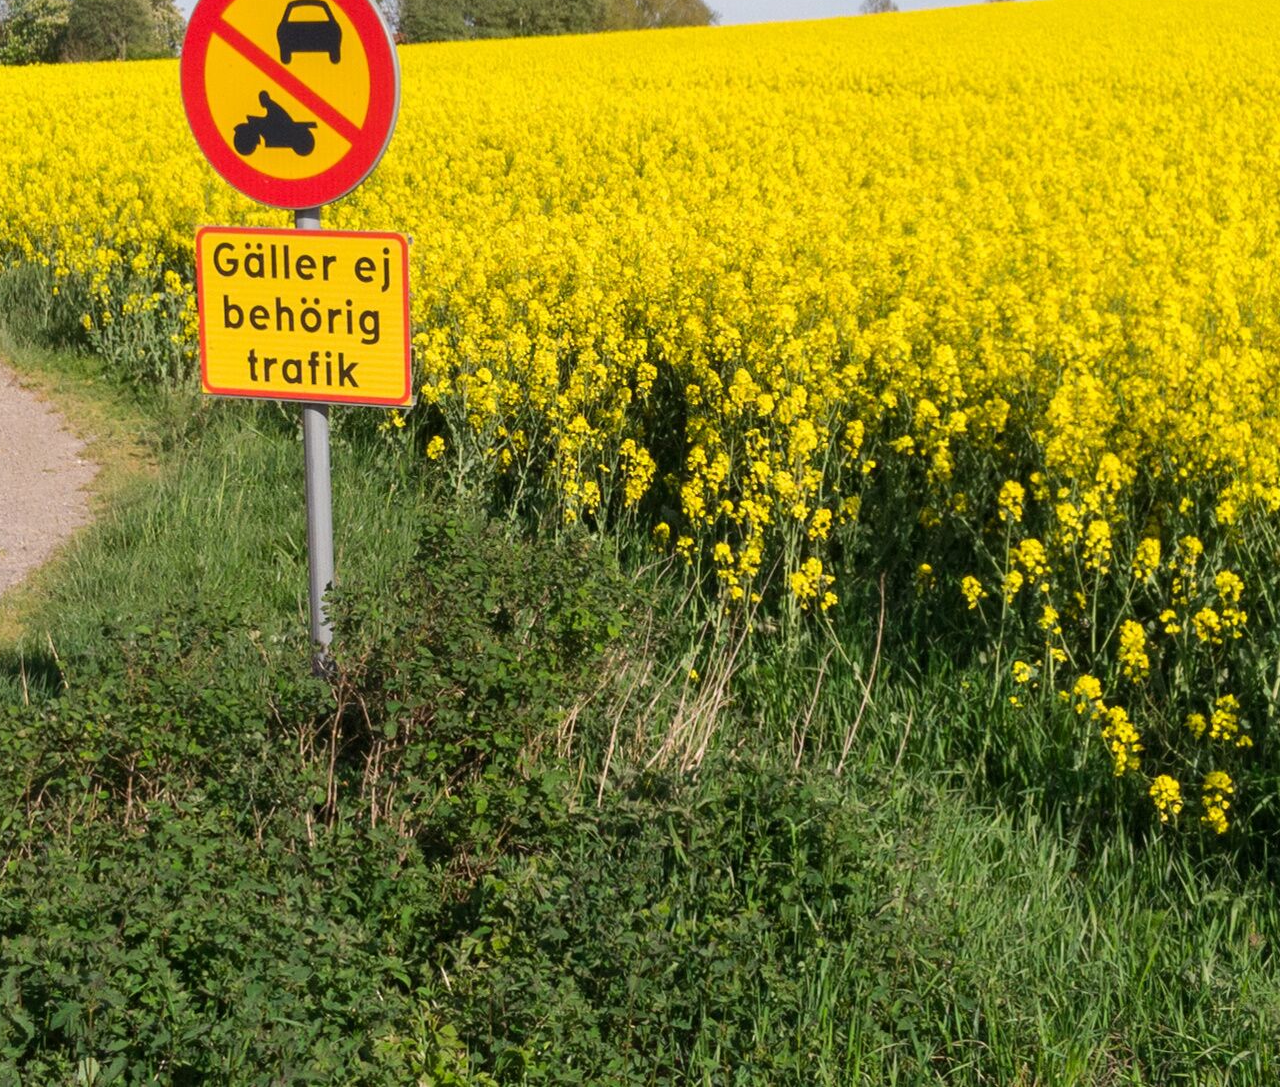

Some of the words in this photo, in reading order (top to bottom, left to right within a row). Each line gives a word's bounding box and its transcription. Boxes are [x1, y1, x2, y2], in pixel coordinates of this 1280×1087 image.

[213, 242, 337, 281] Gäller
[354, 247, 391, 292] ej
[223, 294, 380, 345] behörig
[247, 349, 359, 388] trafik
